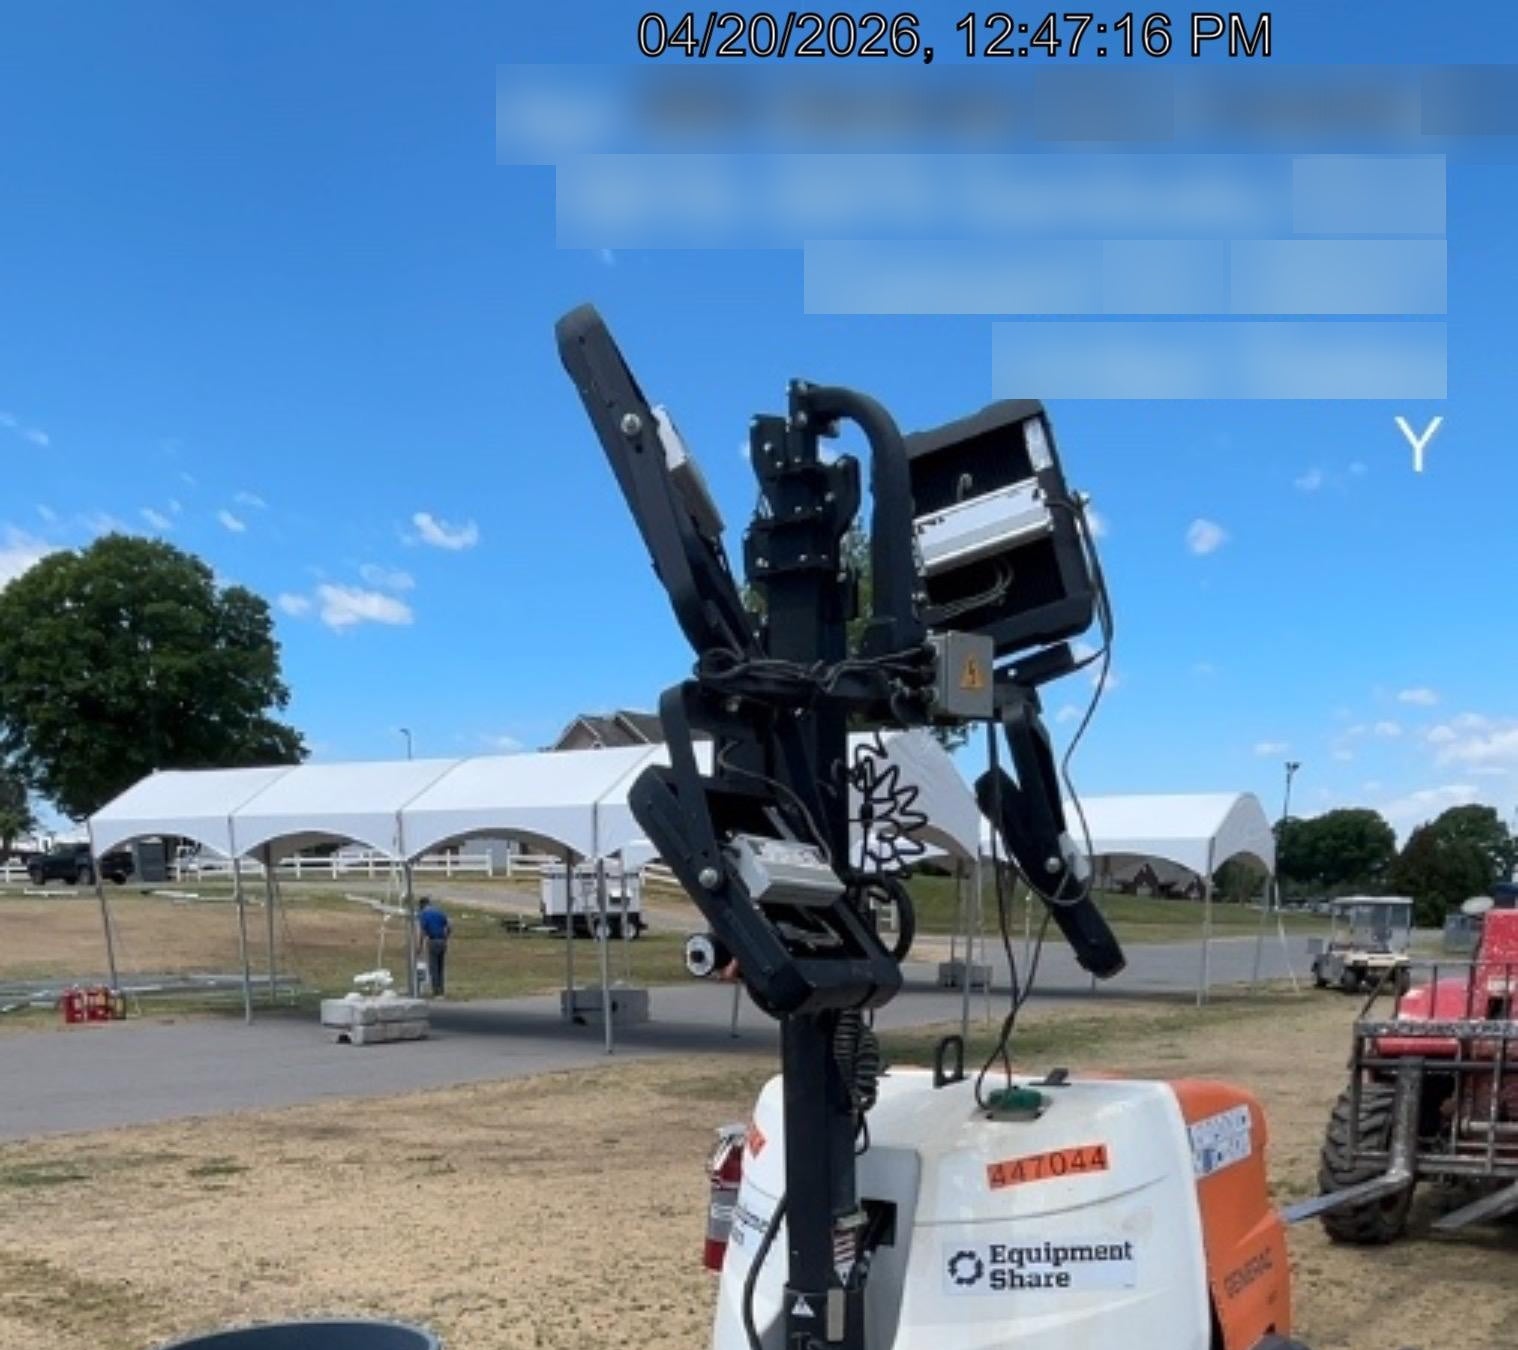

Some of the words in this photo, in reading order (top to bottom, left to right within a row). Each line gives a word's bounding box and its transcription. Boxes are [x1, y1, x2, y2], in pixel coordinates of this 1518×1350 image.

[990, 1146, 1107, 1186] 447044
[988, 1241, 1133, 1268] Equipment
[988, 1268, 1071, 1290] Share
